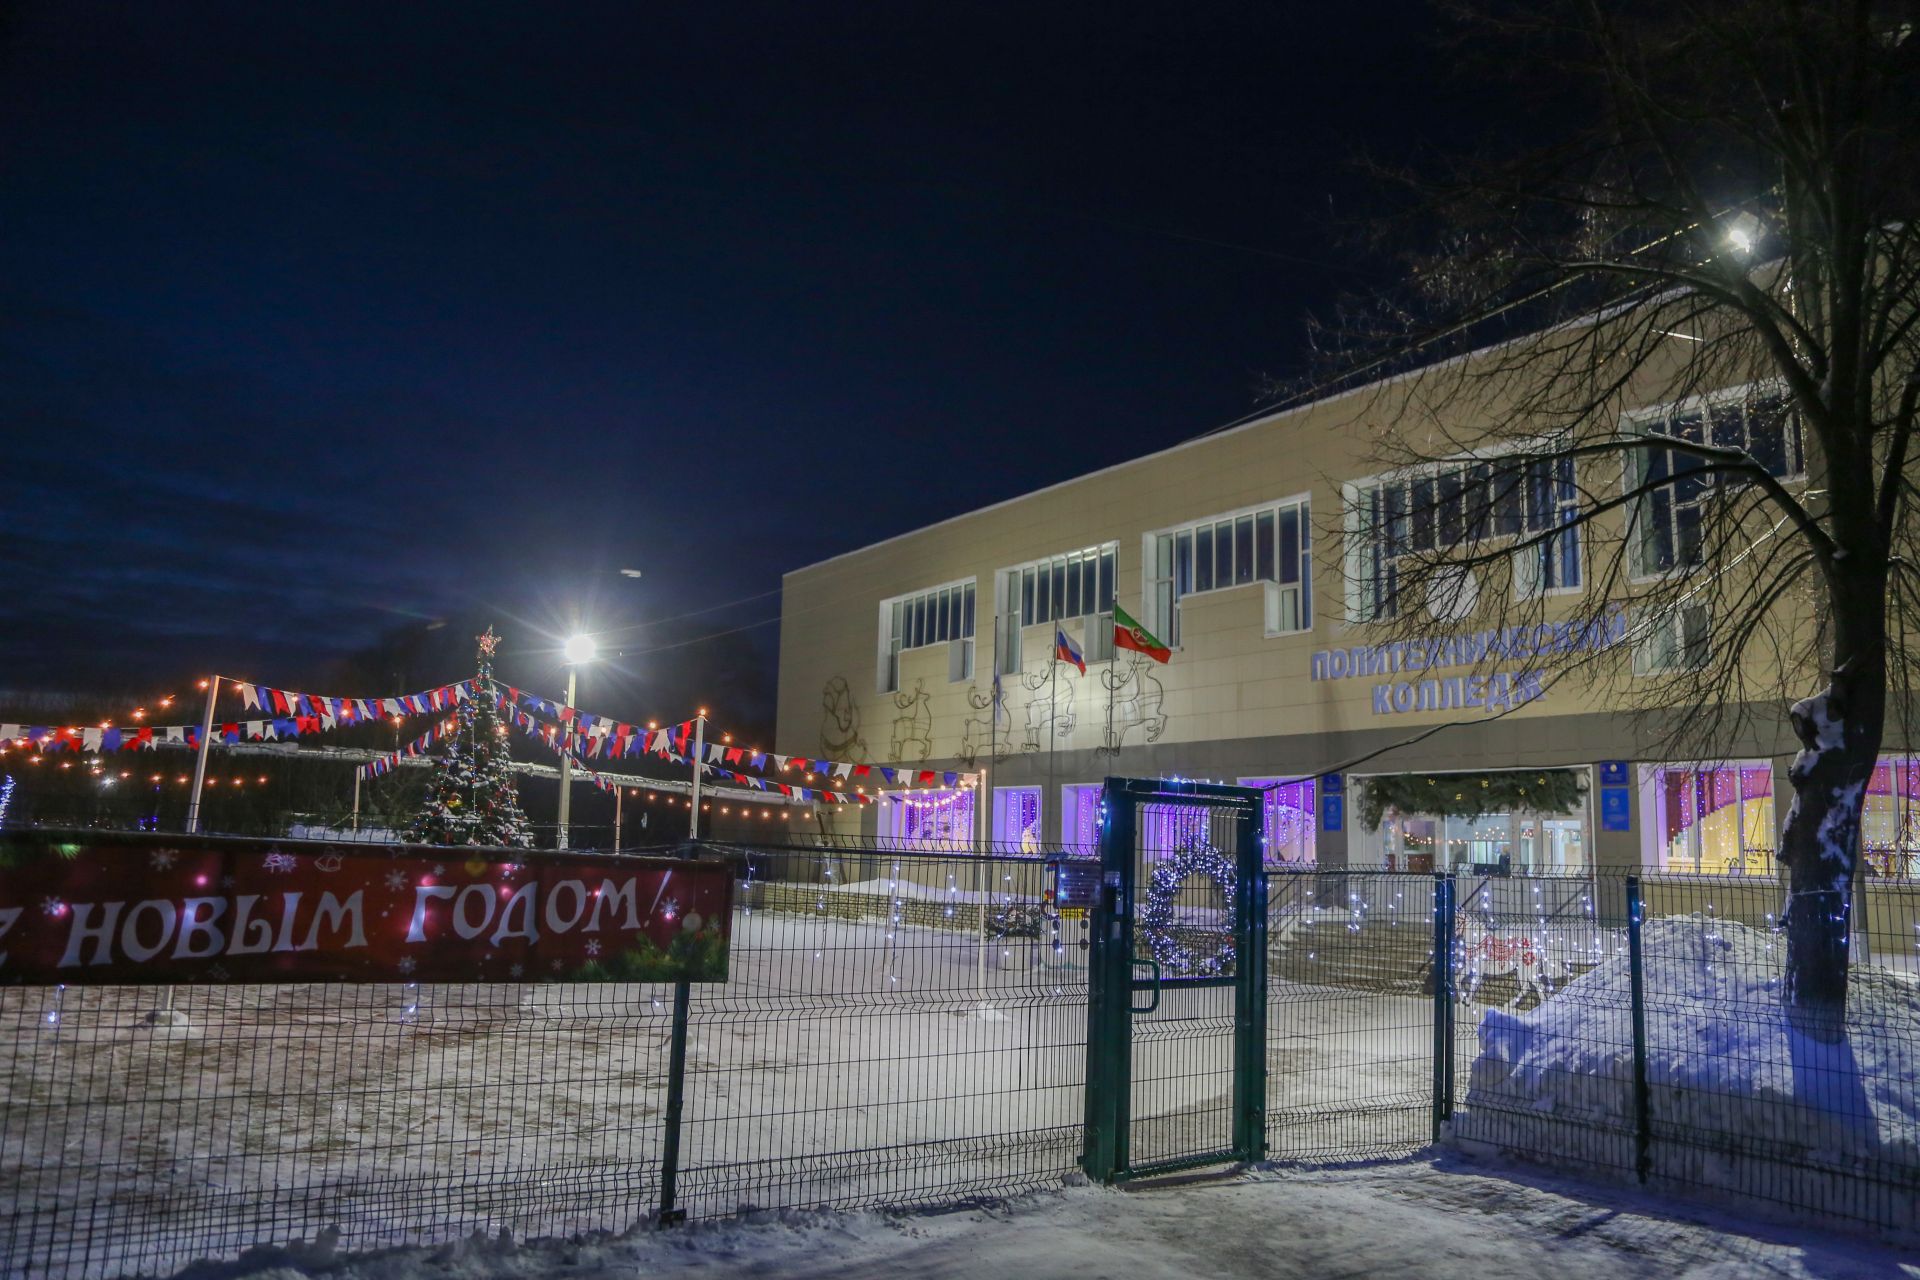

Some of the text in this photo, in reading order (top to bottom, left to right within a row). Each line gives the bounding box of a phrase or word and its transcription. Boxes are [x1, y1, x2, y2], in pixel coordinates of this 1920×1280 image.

[1312, 602, 1626, 682] ПОЛИТЕХНИЧЕСКИЙ
[1373, 671, 1546, 716] КОЛЛЕДЖ
[57, 892, 367, 968] НОВЫМ
[405, 869, 674, 948] ГОДОМ!
